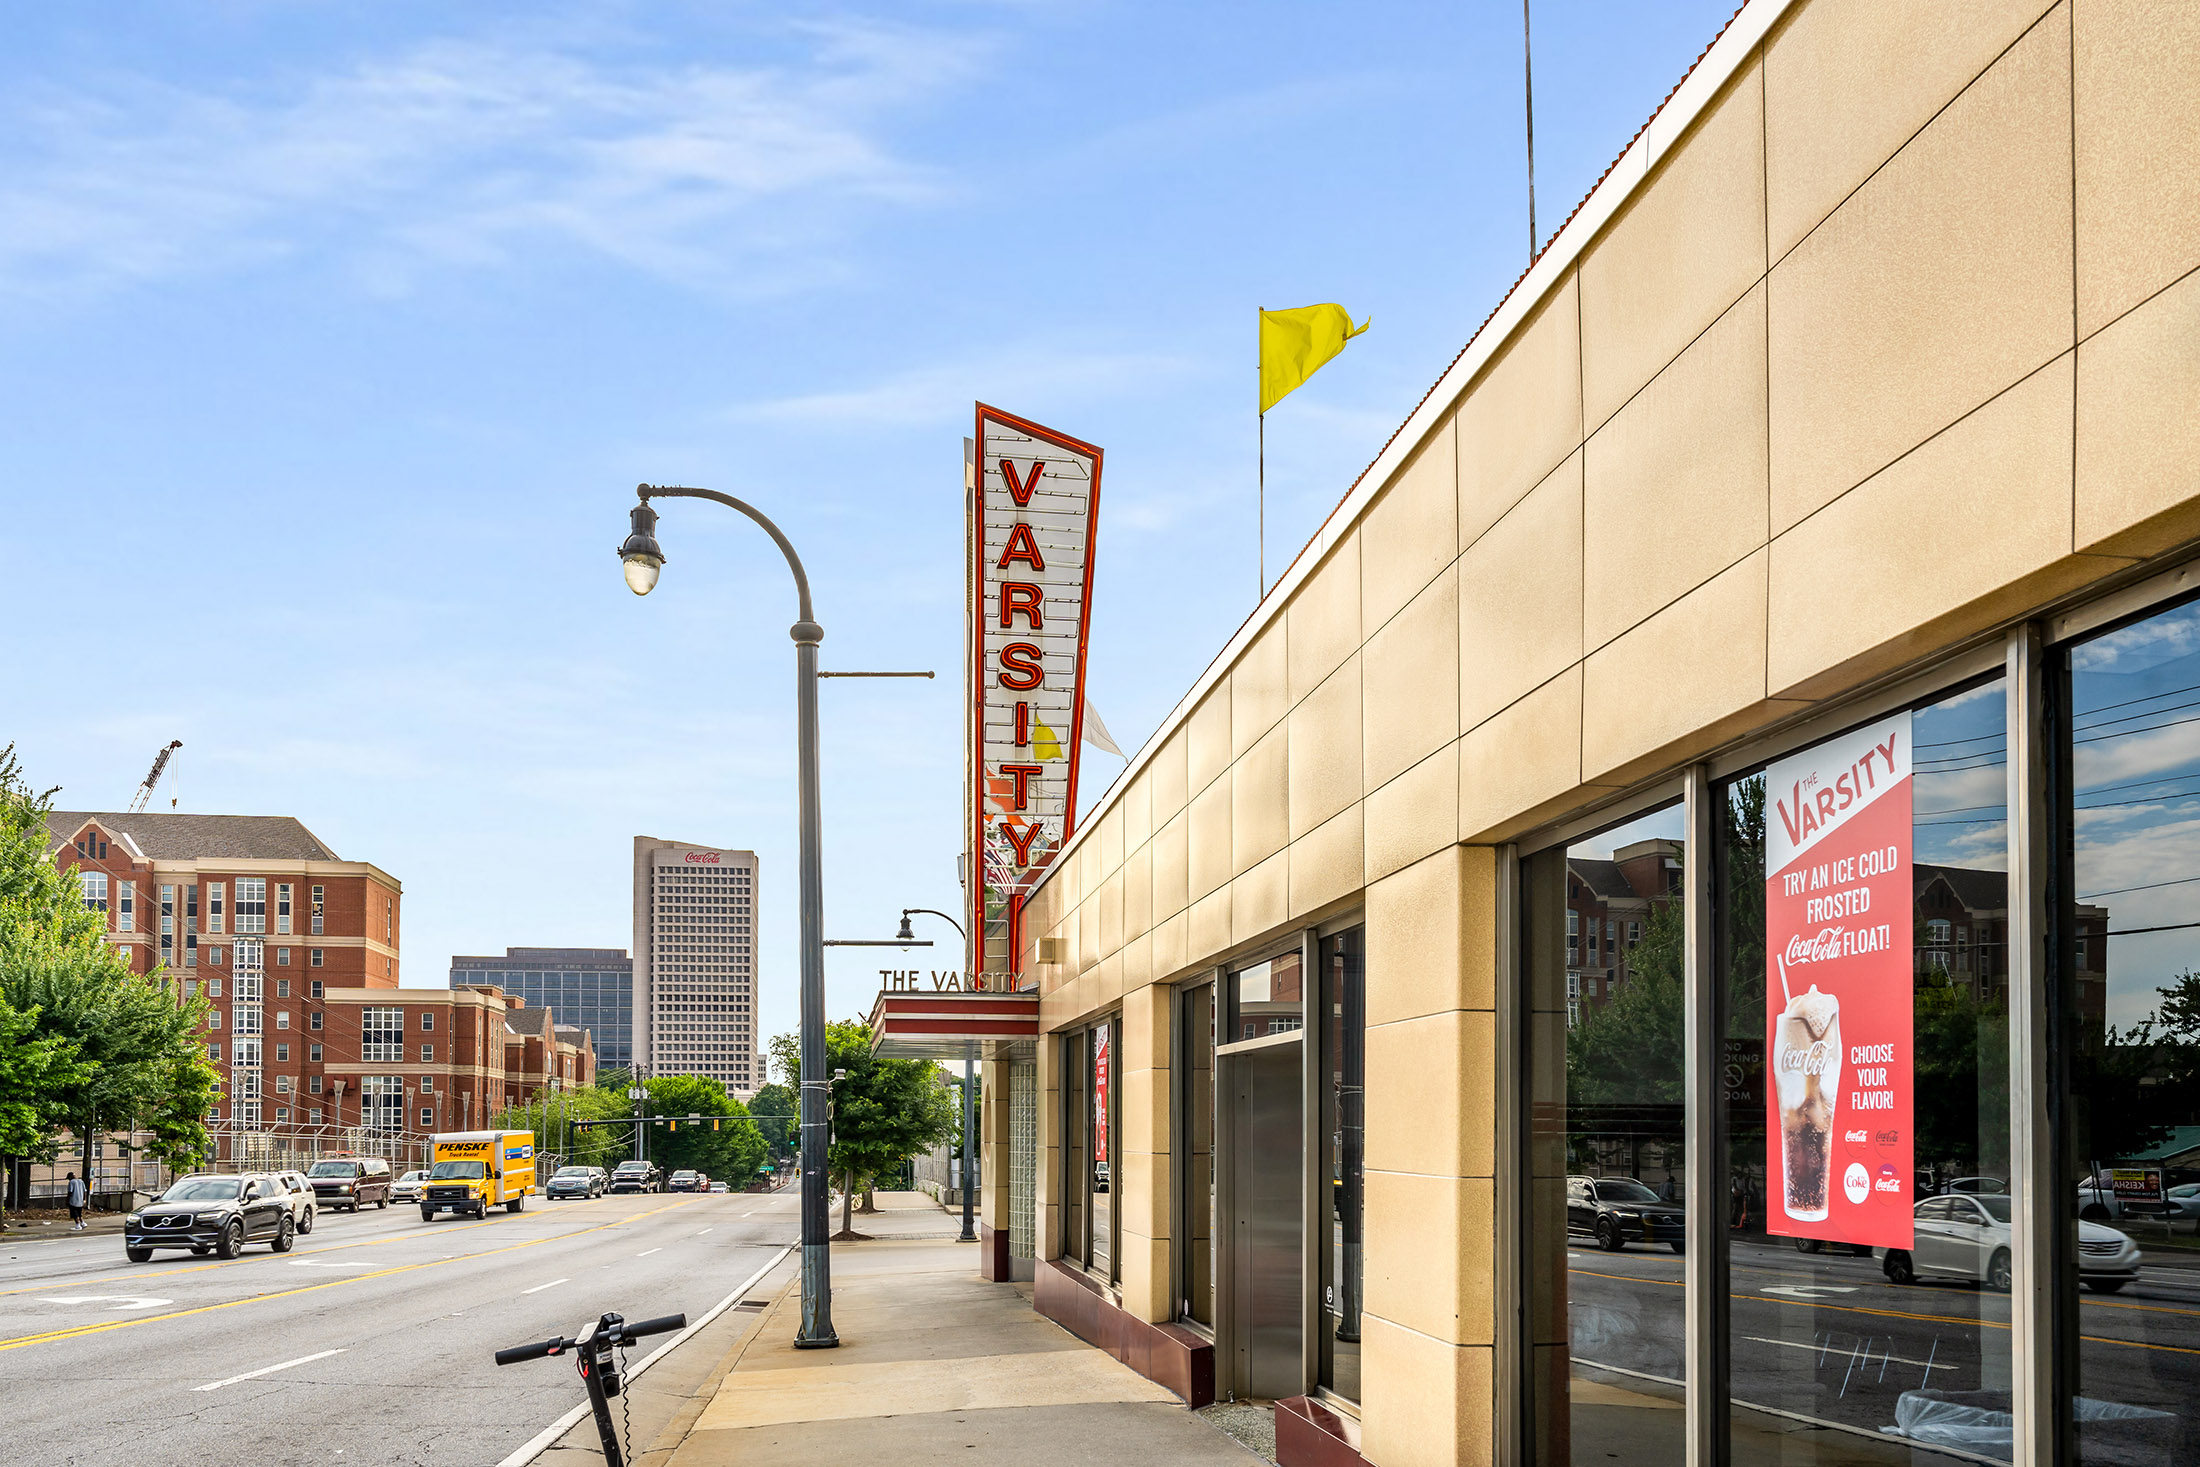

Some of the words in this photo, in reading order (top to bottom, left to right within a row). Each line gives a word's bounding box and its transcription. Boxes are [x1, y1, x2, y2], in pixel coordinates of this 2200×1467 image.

[997, 459, 1045, 868] VARSITY
[1776, 732, 1896, 848] VARSITY
[1802, 771, 1818, 792] THE
[685, 851, 721, 864] Coca-Cola
[1783, 869, 1807, 897] TRY
[1810, 863, 1829, 891] AN
[1833, 856, 1855, 885] ICE
[1859, 846, 1898, 878] COLD
[1807, 887, 1870, 924] FROSTED
[1785, 925, 1844, 967] Coca-Cola
[1843, 925, 1890, 956] FLOAT!
[879, 970, 920, 992] THE
[931, 970, 1025, 992] VARSITY
[1725, 1042, 1741, 1051] NO
[1851, 1043, 1894, 1065] CHOOSE
[1857, 1067, 1887, 1087] YOUR
[1851, 1090, 1893, 1110] FLAVOR!
[439, 1143, 490, 1152] PENSKE
[1846, 1175, 1868, 1188] Coke
